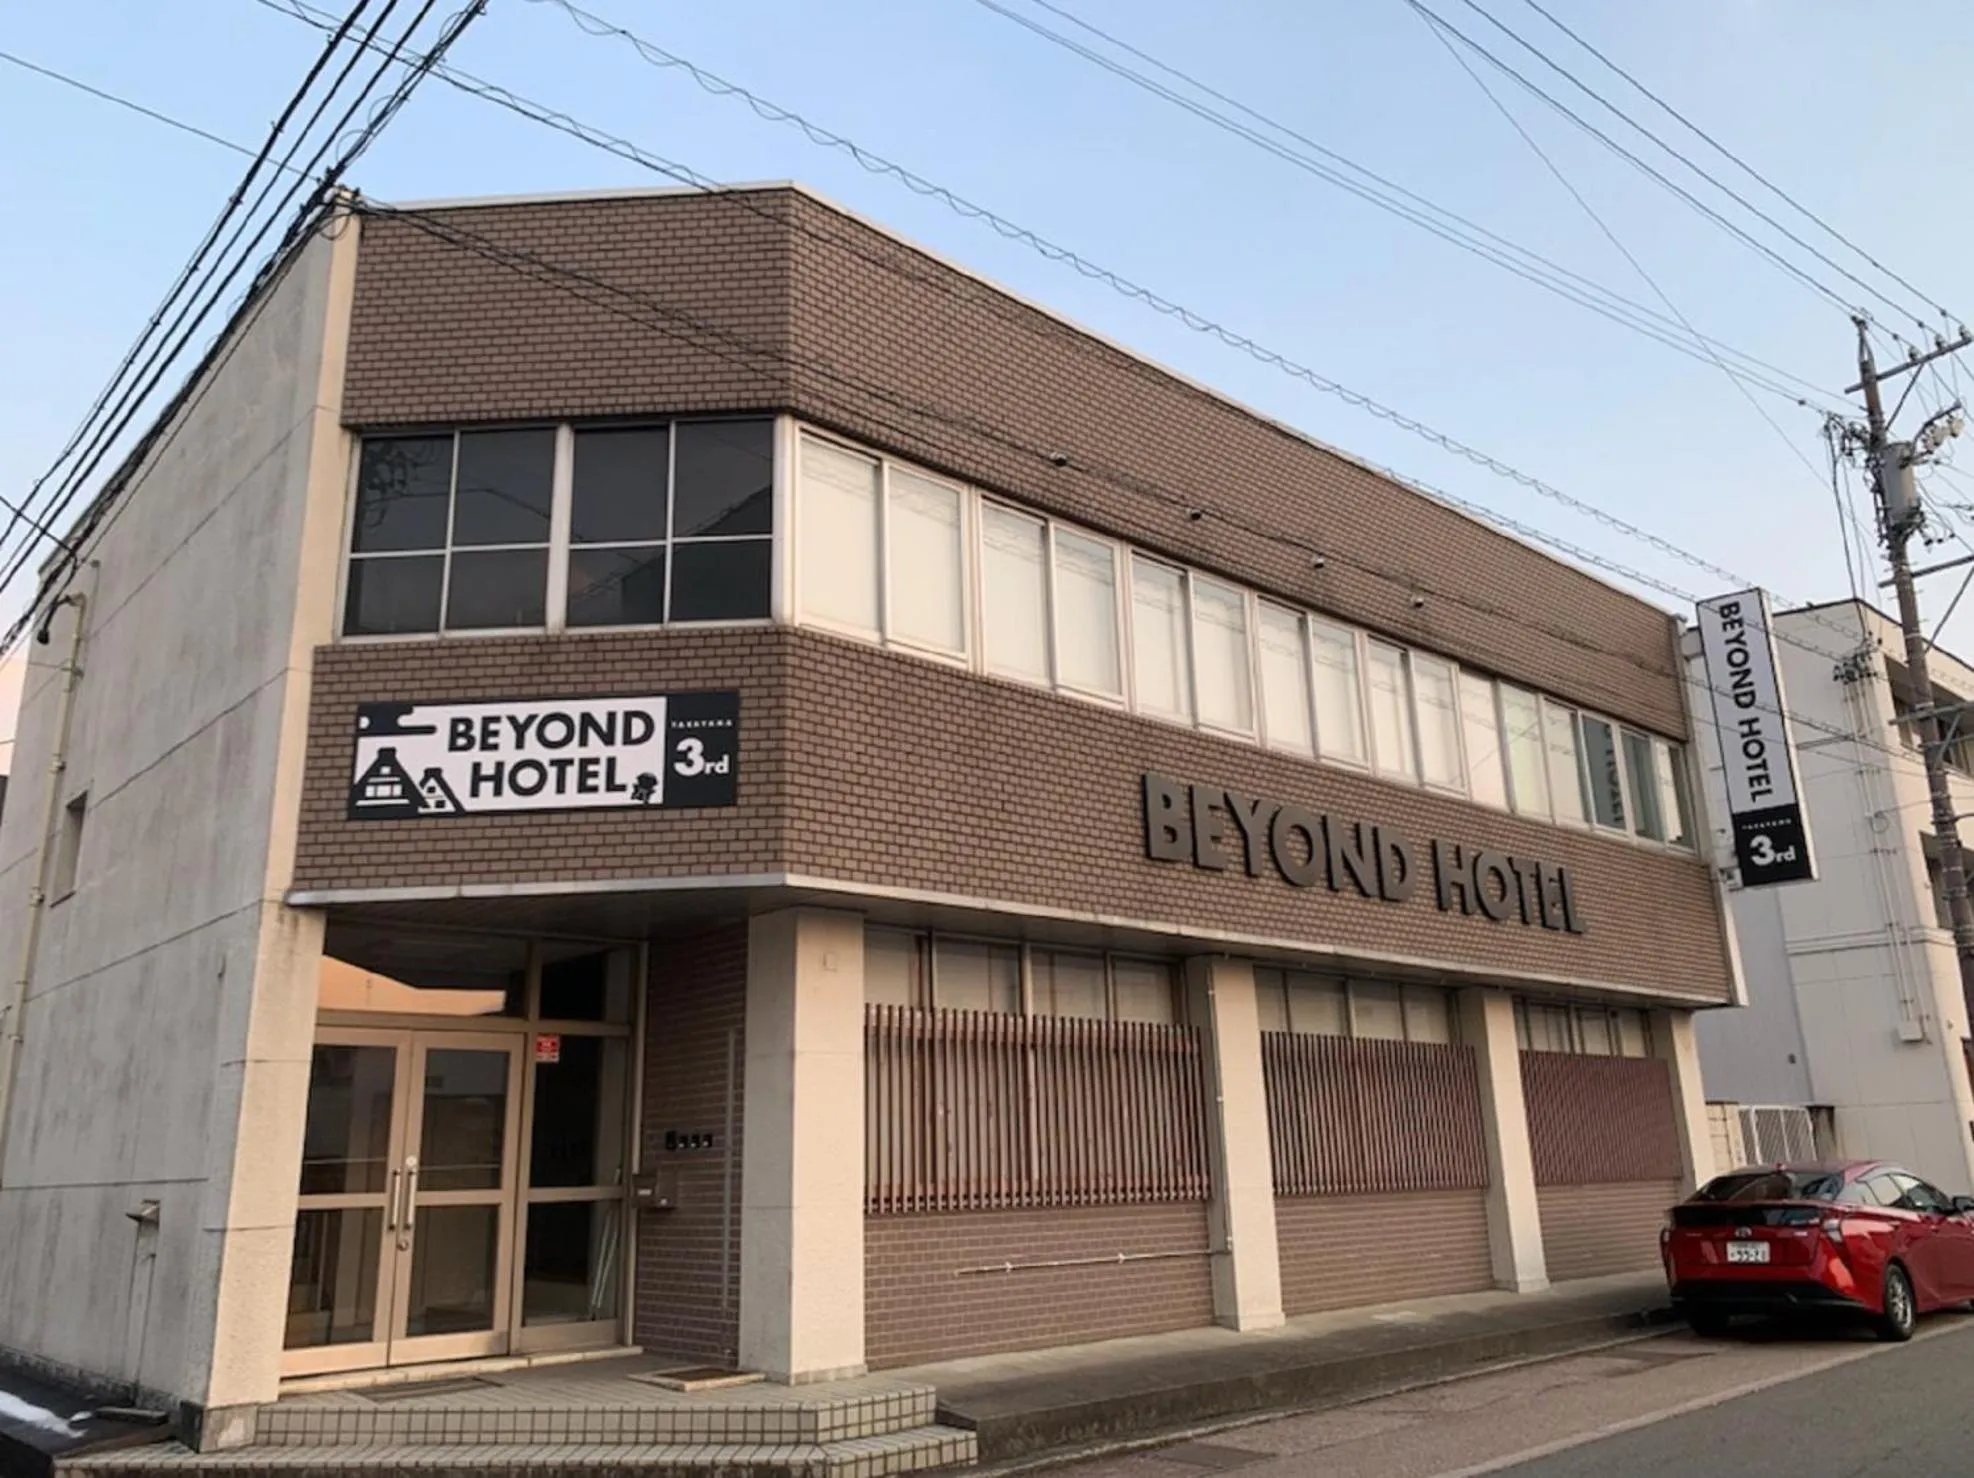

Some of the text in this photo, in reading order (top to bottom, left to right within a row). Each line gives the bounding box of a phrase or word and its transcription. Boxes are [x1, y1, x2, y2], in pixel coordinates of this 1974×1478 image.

[1719, 601, 1756, 710] BEYOND
[1738, 717, 1773, 803] HOTEL
[448, 710, 655, 752] BEYOND
[469, 757, 627, 797] HOTEL
[673, 737, 729, 776] 3rd
[1142, 770, 1586, 934] BEYOND HOTEL
[1750, 835, 1796, 866] 3rd
